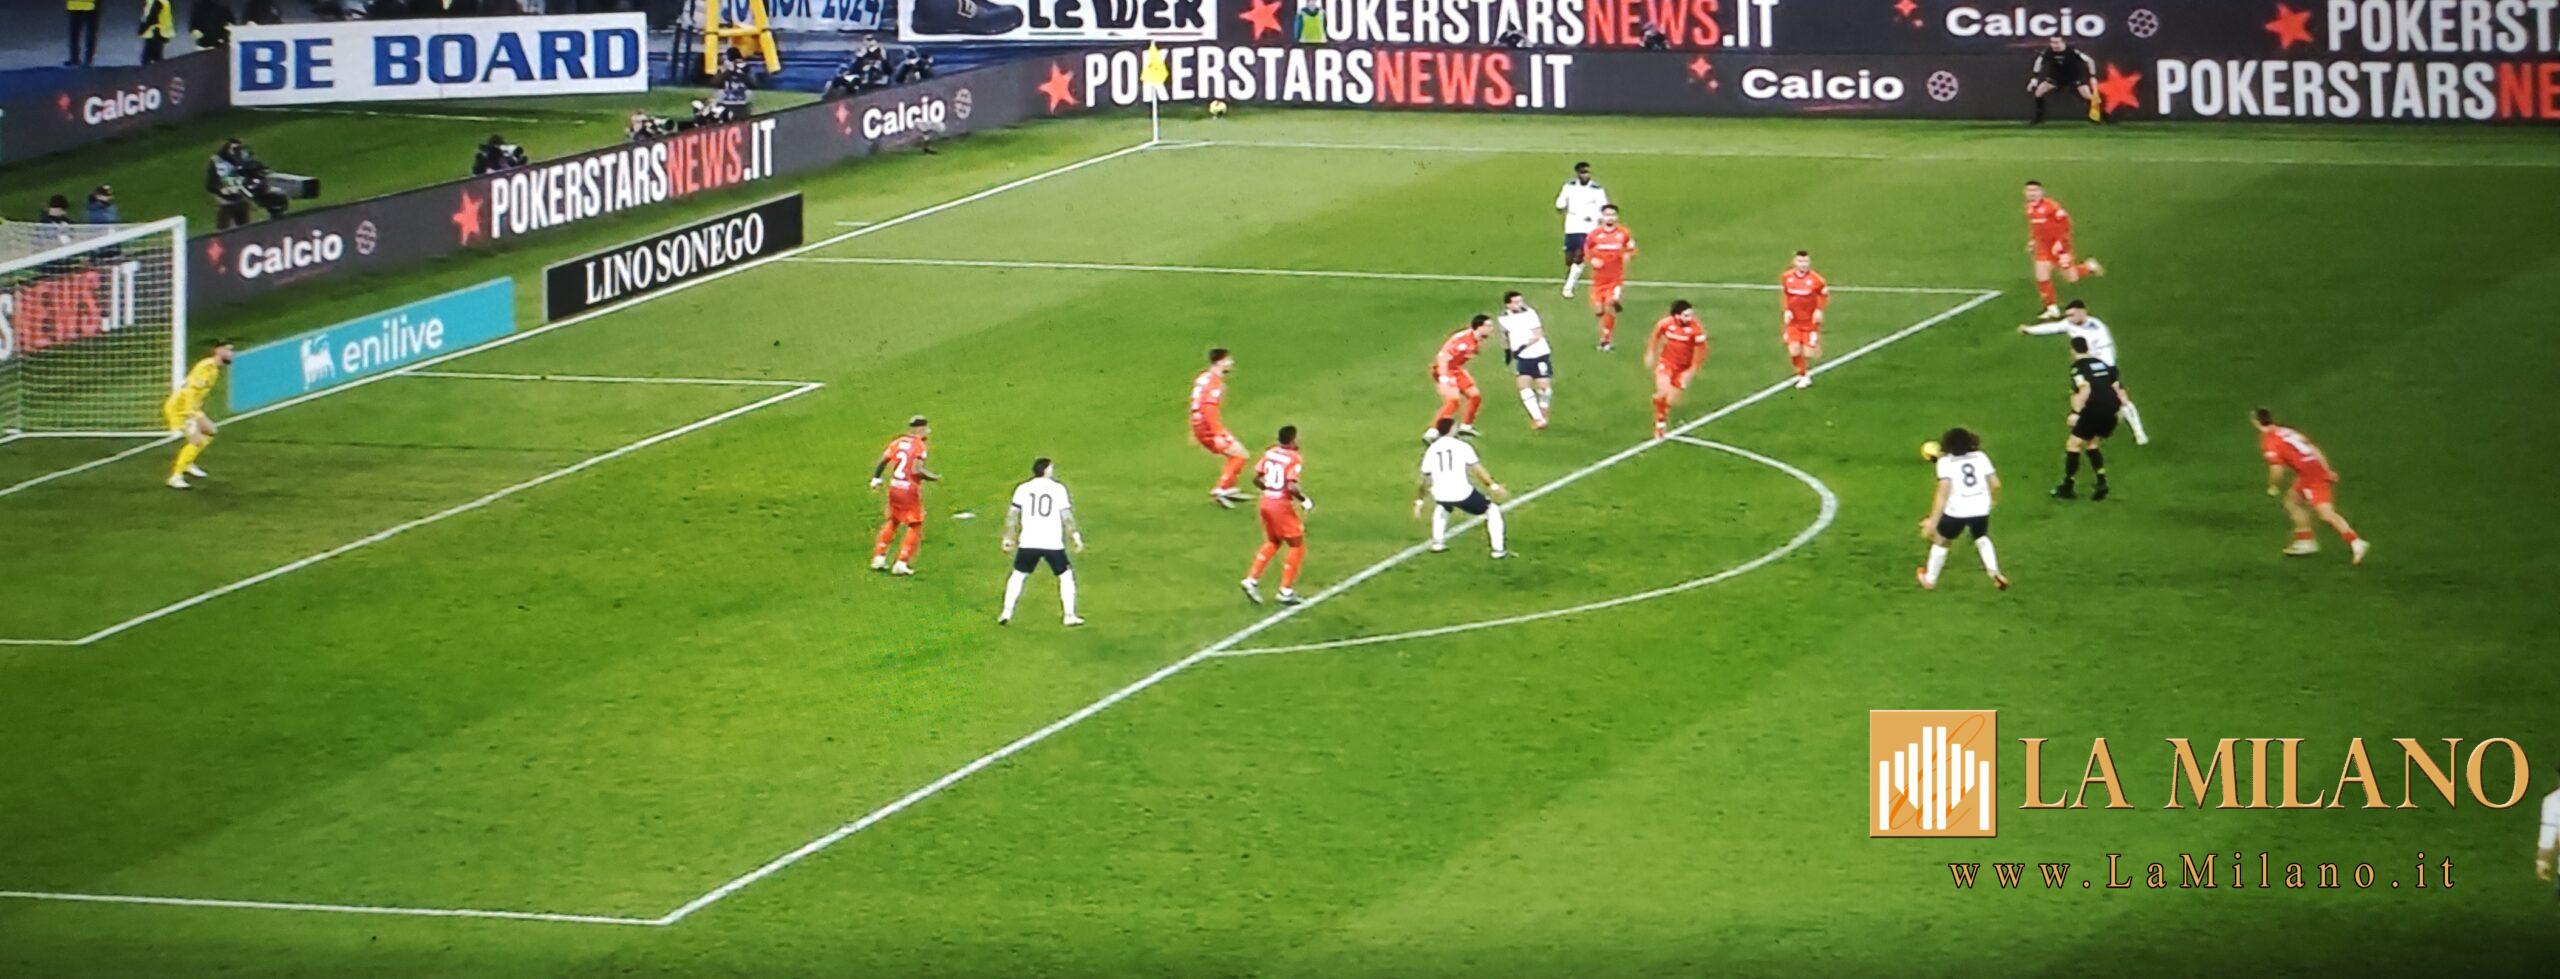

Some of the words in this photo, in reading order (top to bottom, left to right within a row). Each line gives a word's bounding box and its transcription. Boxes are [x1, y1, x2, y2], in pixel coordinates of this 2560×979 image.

[1297, 0, 1779, 47] OKERSTARSNEWS.IT
[1945, 7, 2106, 37] Calcio
[2327, 0, 2560, 53] POKERST
[239, 38, 334, 92] BE
[373, 28, 640, 86] BOARD
[83, 85, 162, 125] Calcio
[1741, 69, 1904, 100] Calcio
[862, 96, 946, 139] Calcio
[490, 118, 777, 239] POKERSTARSNEWS.IT
[238, 229, 344, 279] Calcio
[584, 245, 654, 304] LINO
[655, 212, 764, 283] SONEGO
[341, 313, 444, 374] enilive
[894, 449, 908, 480] 2
[1436, 448, 1453, 473] 11
[1960, 462, 1978, 488] 8
[1028, 491, 1053, 517] 10
